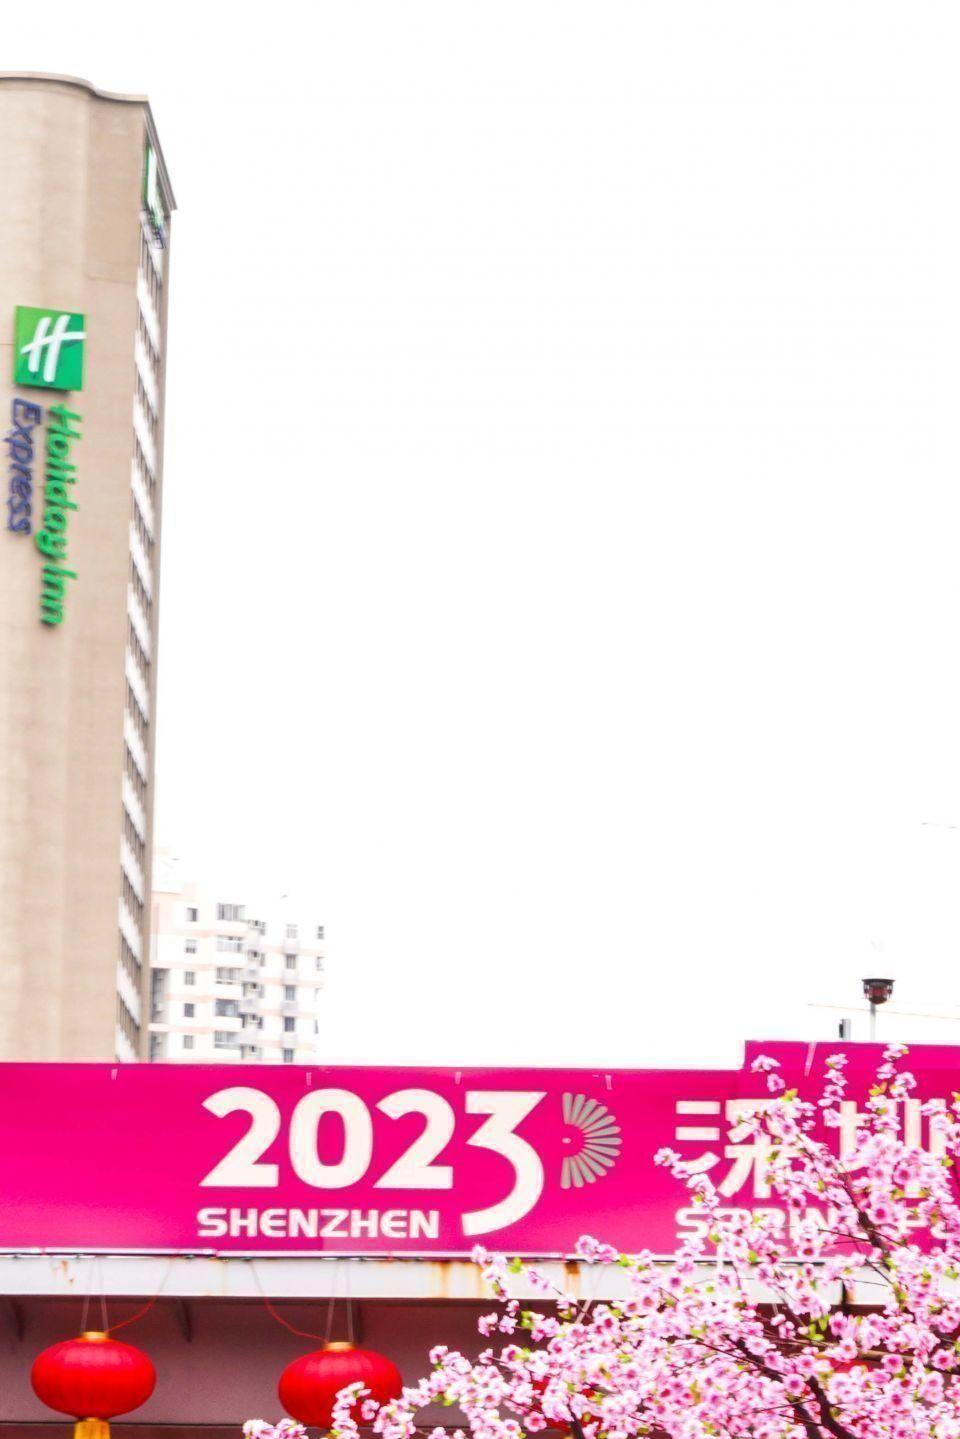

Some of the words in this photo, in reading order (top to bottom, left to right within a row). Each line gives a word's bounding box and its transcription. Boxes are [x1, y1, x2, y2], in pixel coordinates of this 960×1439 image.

[3, 398, 43, 535] Express
[34, 403, 82, 561] Holiday
[40, 563, 78, 627] Inn
[197, 1207, 440, 1239] SHENZHEN
[200, 1087, 547, 1236] 2023
